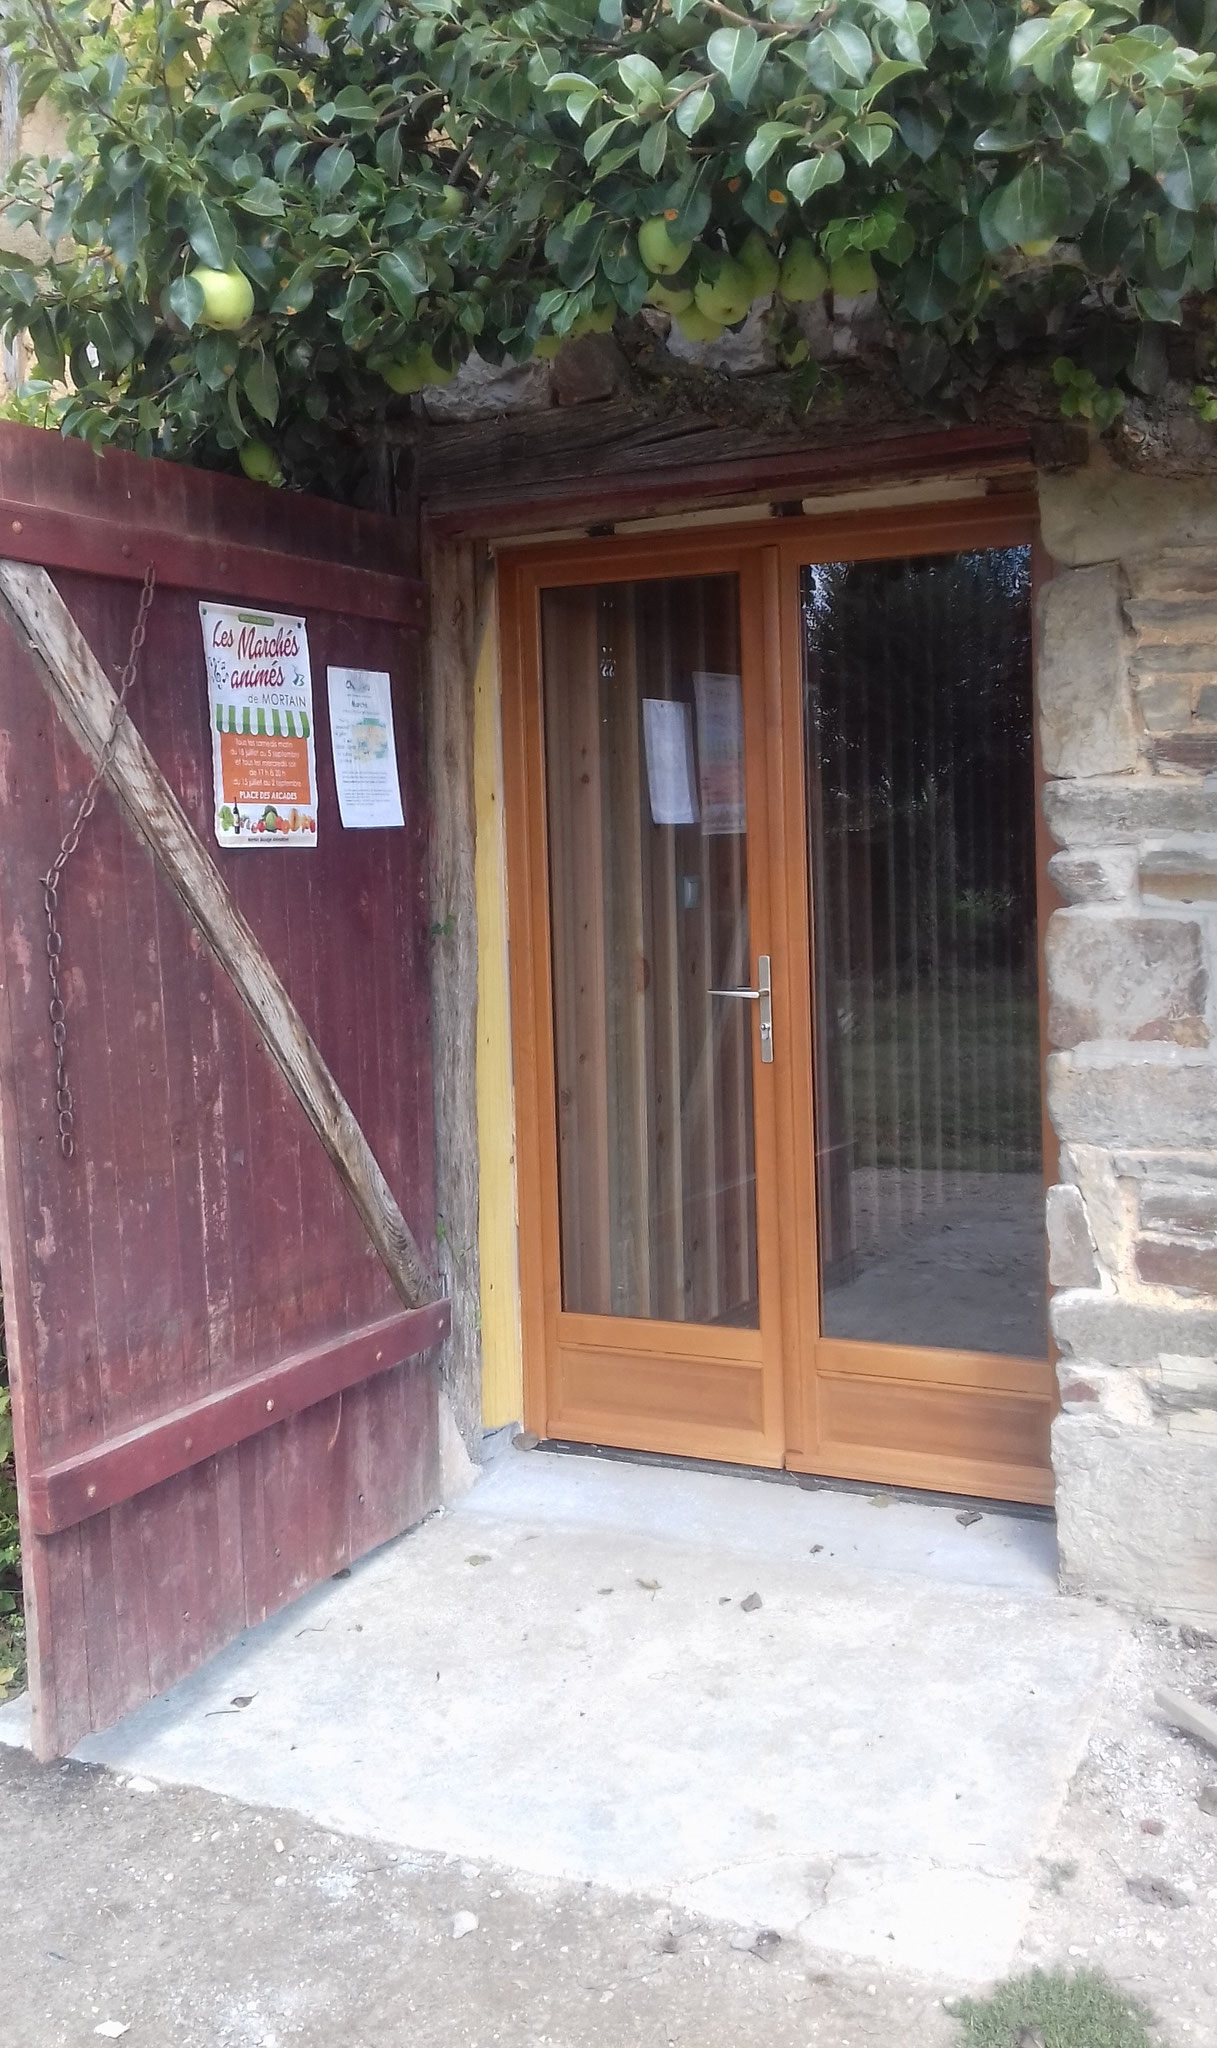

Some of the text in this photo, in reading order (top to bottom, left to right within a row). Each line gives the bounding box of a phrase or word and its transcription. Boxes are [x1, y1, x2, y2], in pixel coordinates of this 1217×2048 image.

[213, 620, 300, 660] Les Marchés
[230, 660, 285, 689] animés
[248, 693, 306, 707] de MORTAIN
[267, 749, 272, 757] 5
[239, 790, 297, 800] PLACE DES ARCADES
